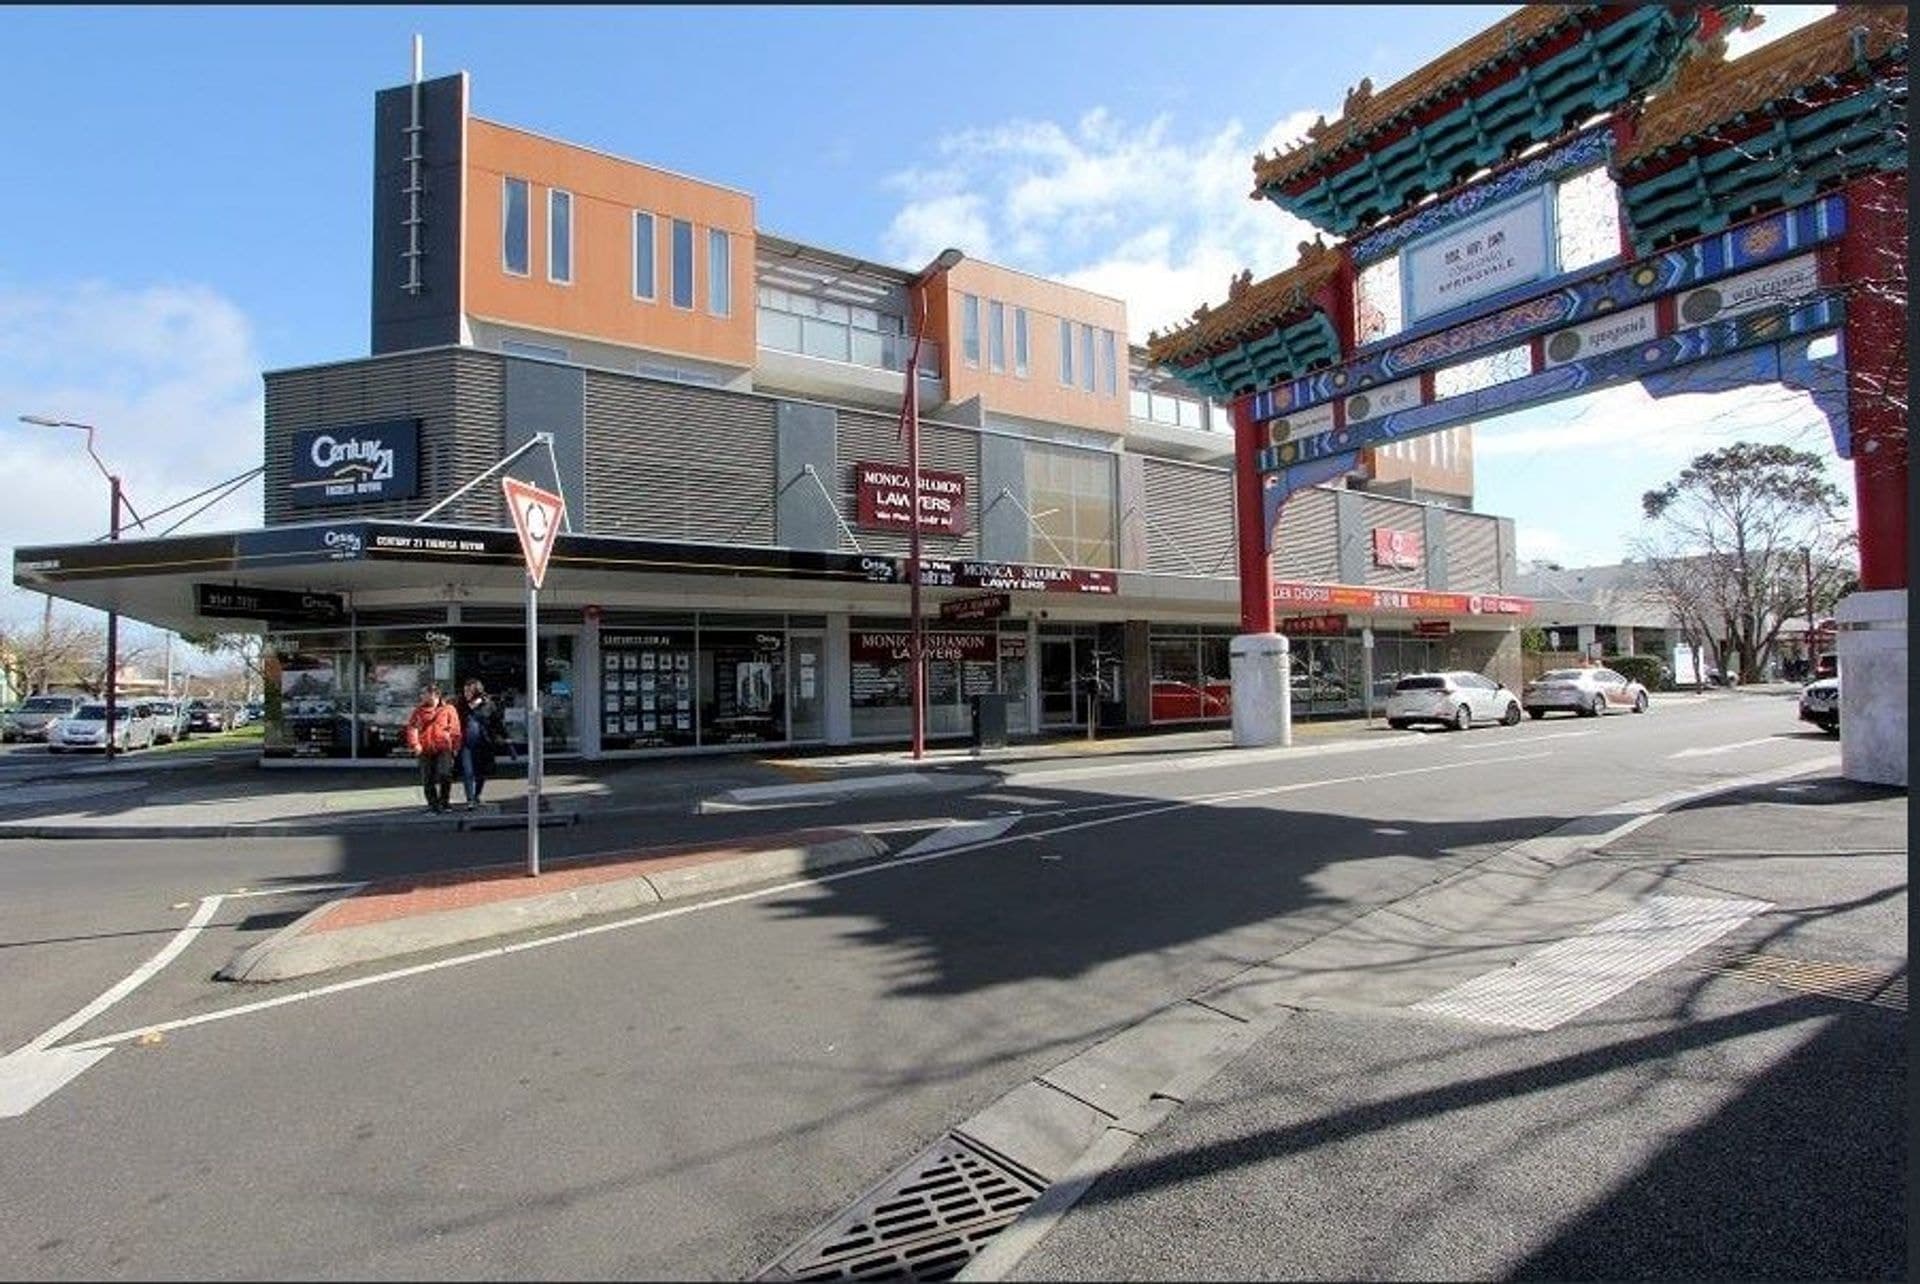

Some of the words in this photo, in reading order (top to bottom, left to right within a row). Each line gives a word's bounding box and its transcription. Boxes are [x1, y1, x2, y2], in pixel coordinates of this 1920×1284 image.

[373, 449, 393, 480] 21
[864, 471, 910, 488] MONICA
[963, 564, 1014, 579] MONICA
[1022, 567, 1072, 582] SHAMON
[980, 577, 1046, 591] LAWYERS
[862, 634, 911, 649] MONIC
[925, 634, 985, 648] SHAMON
[891, 648, 964, 660] LAYERS
